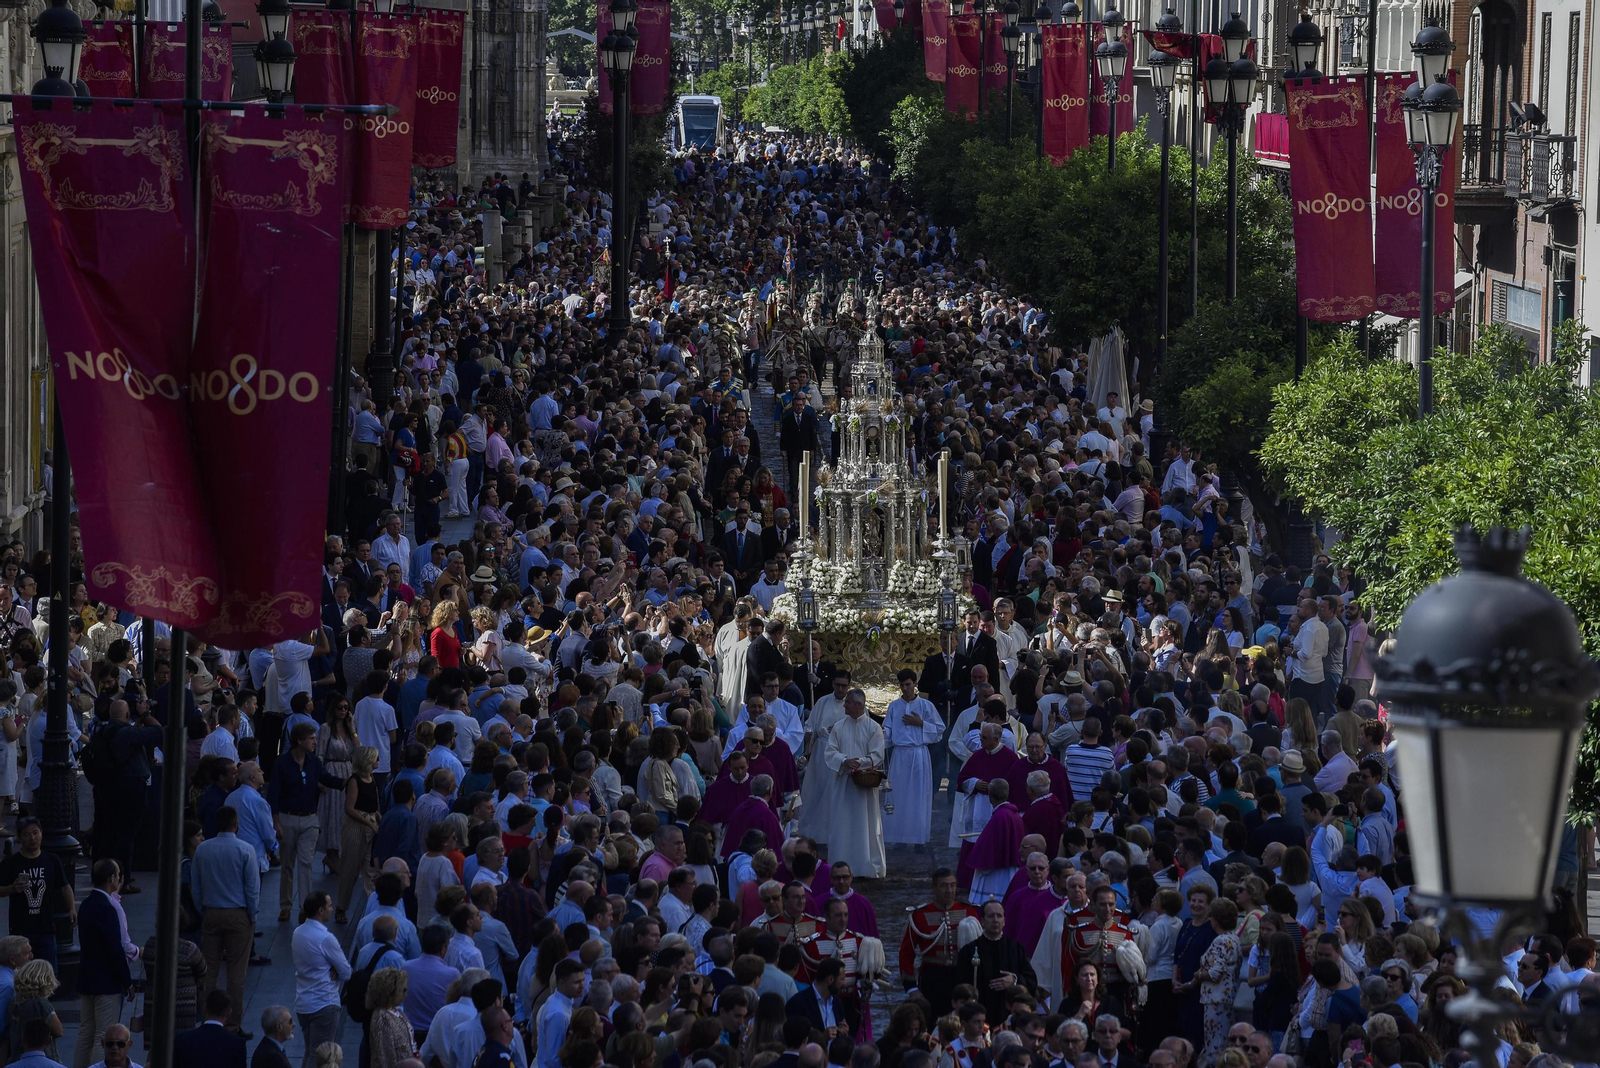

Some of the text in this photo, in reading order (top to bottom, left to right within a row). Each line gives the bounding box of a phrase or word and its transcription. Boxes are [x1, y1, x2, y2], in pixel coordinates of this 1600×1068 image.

[948, 64, 977, 78] NO8DO
[985, 62, 1007, 76] NO8D
[1045, 93, 1085, 111] NO8DO
[358, 114, 410, 139] NO8DO
[1297, 192, 1366, 220] NO8DO
[1379, 187, 1449, 216] NO8O
[63, 347, 181, 401] NO8DO
[189, 353, 320, 416] NO8DO
